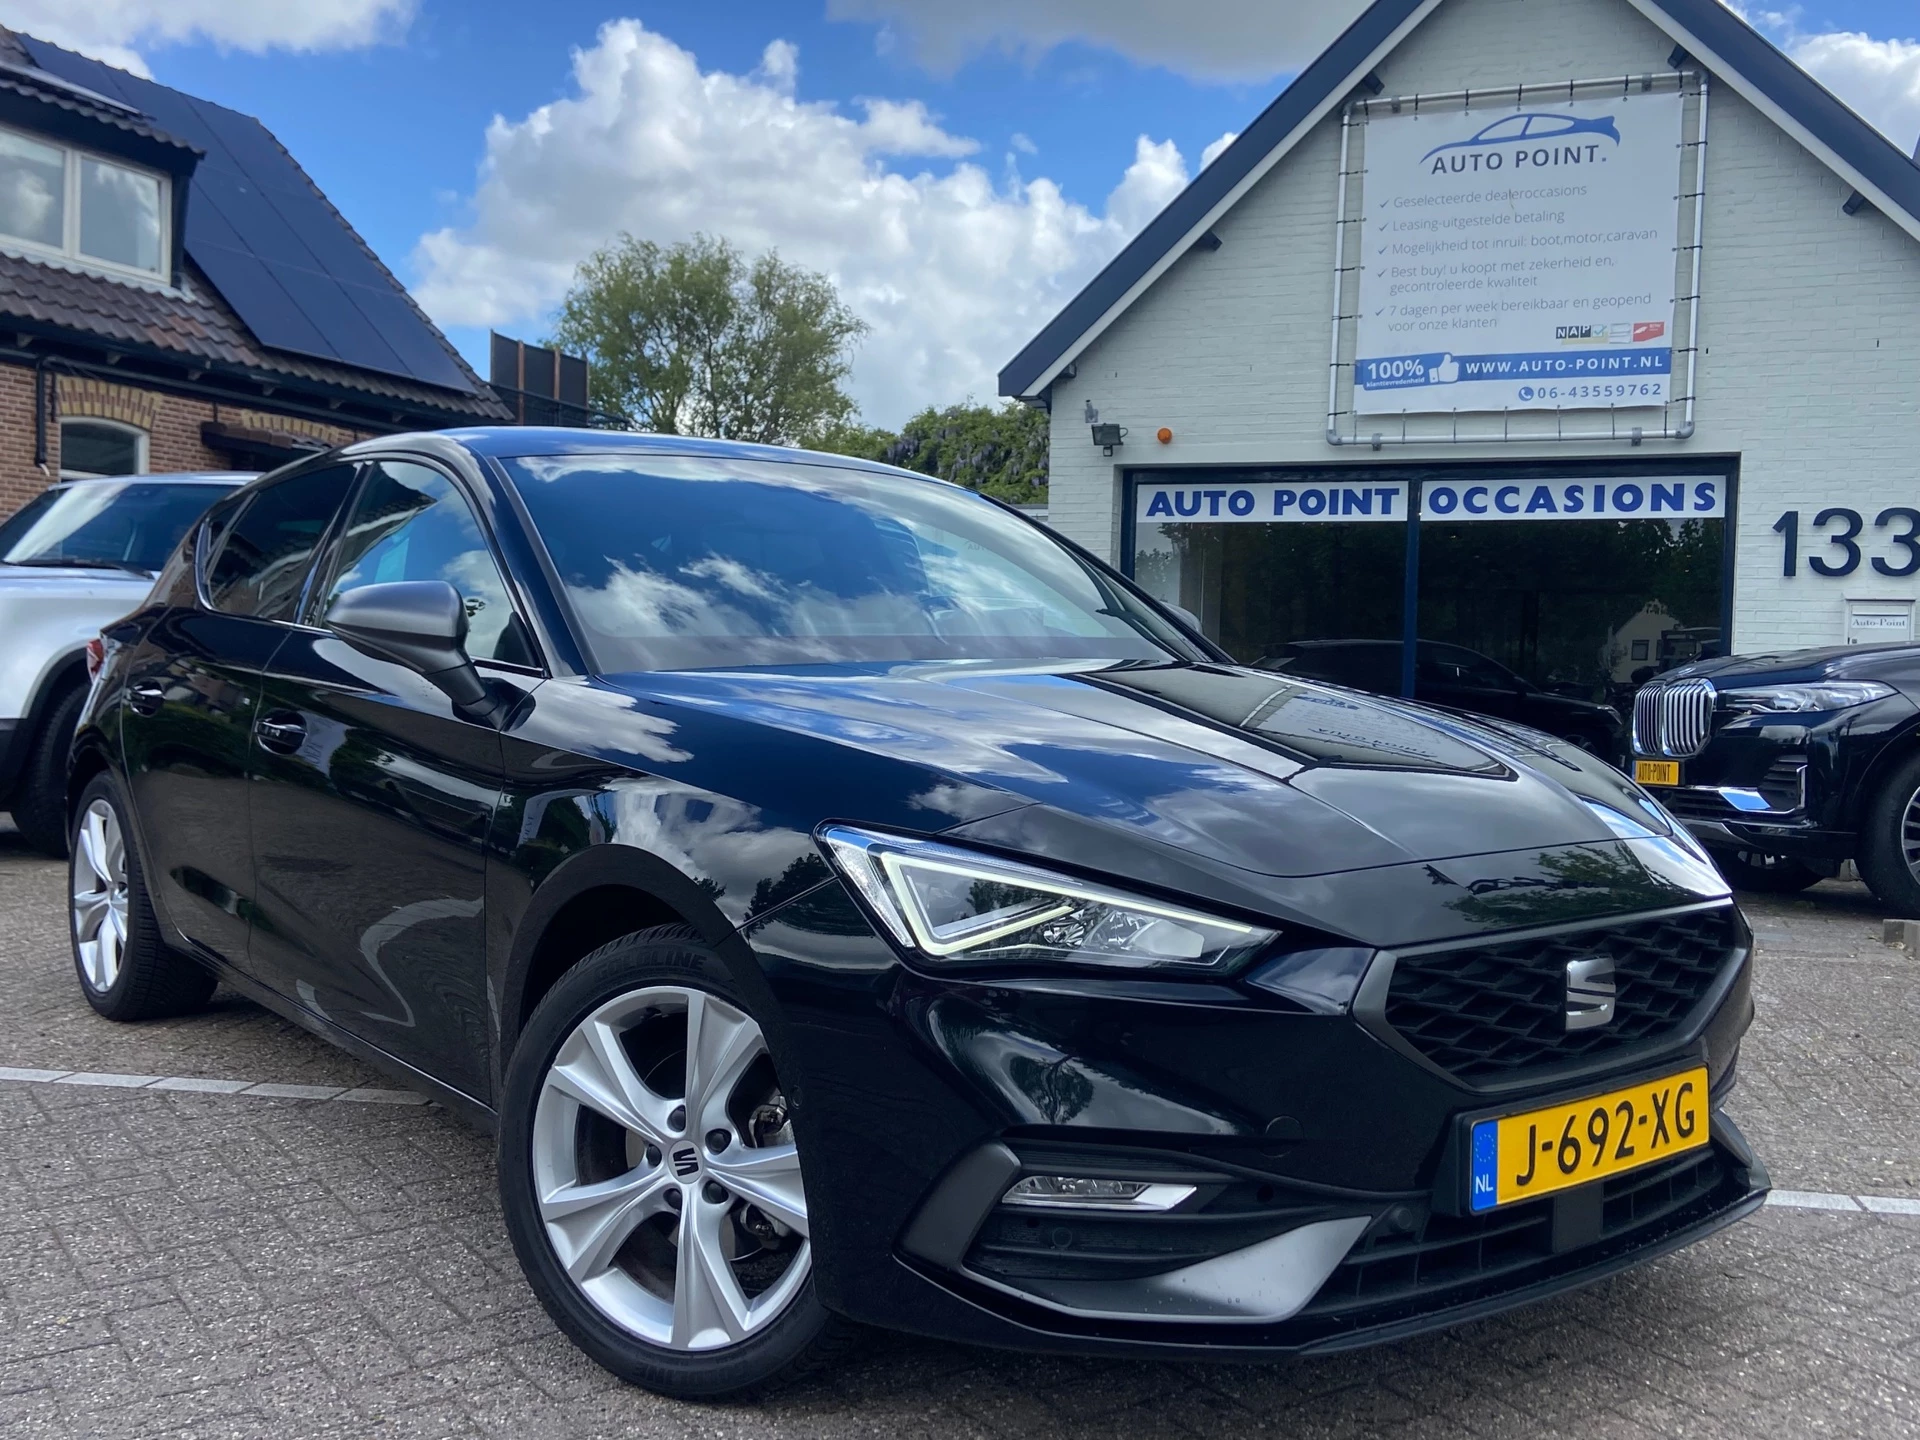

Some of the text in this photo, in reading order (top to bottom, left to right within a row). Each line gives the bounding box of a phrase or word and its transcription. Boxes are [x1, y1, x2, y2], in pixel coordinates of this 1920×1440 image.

[1431, 152, 1503, 175] AUTO
[1393, 185, 1588, 208] Geselecteerde dealeroccasions
[1392, 210, 1565, 232] Leasing-uitgestelde betaling
[1392, 229, 1658, 257] Mogelijkheid tot inruil: boot,motor,caravan
[1391, 266, 1417, 278] Best
[1420, 264, 1446, 279] buy!
[1449, 265, 1458, 275] u
[1461, 262, 1497, 275] koopt
[1500, 260, 1525, 272] met
[1529, 255, 1592, 271] zekerheid
[1389, 275, 1538, 297] gecontroleerde kwaliteit
[1389, 292, 1651, 318] 7 dagen per week bereikbaar en geopend
[1388, 317, 1497, 332] voor onze klanten
[1556, 325, 1591, 339] NAP
[1367, 358, 1424, 380] 100%
[1466, 355, 1663, 374] WWW.AUTO-POINT.NL
[1537, 383, 1661, 399] 06-43559762
[1146, 481, 1716, 518] AUTO POINT OCCASIONS
[1772, 507, 1920, 577] 133
[1852, 618, 1905, 627] Auto-Point
[1637, 762, 1671, 783] AUTO-POINT
[1516, 1082, 1695, 1187] J-692-XG
[1475, 1173, 1494, 1195] NL
